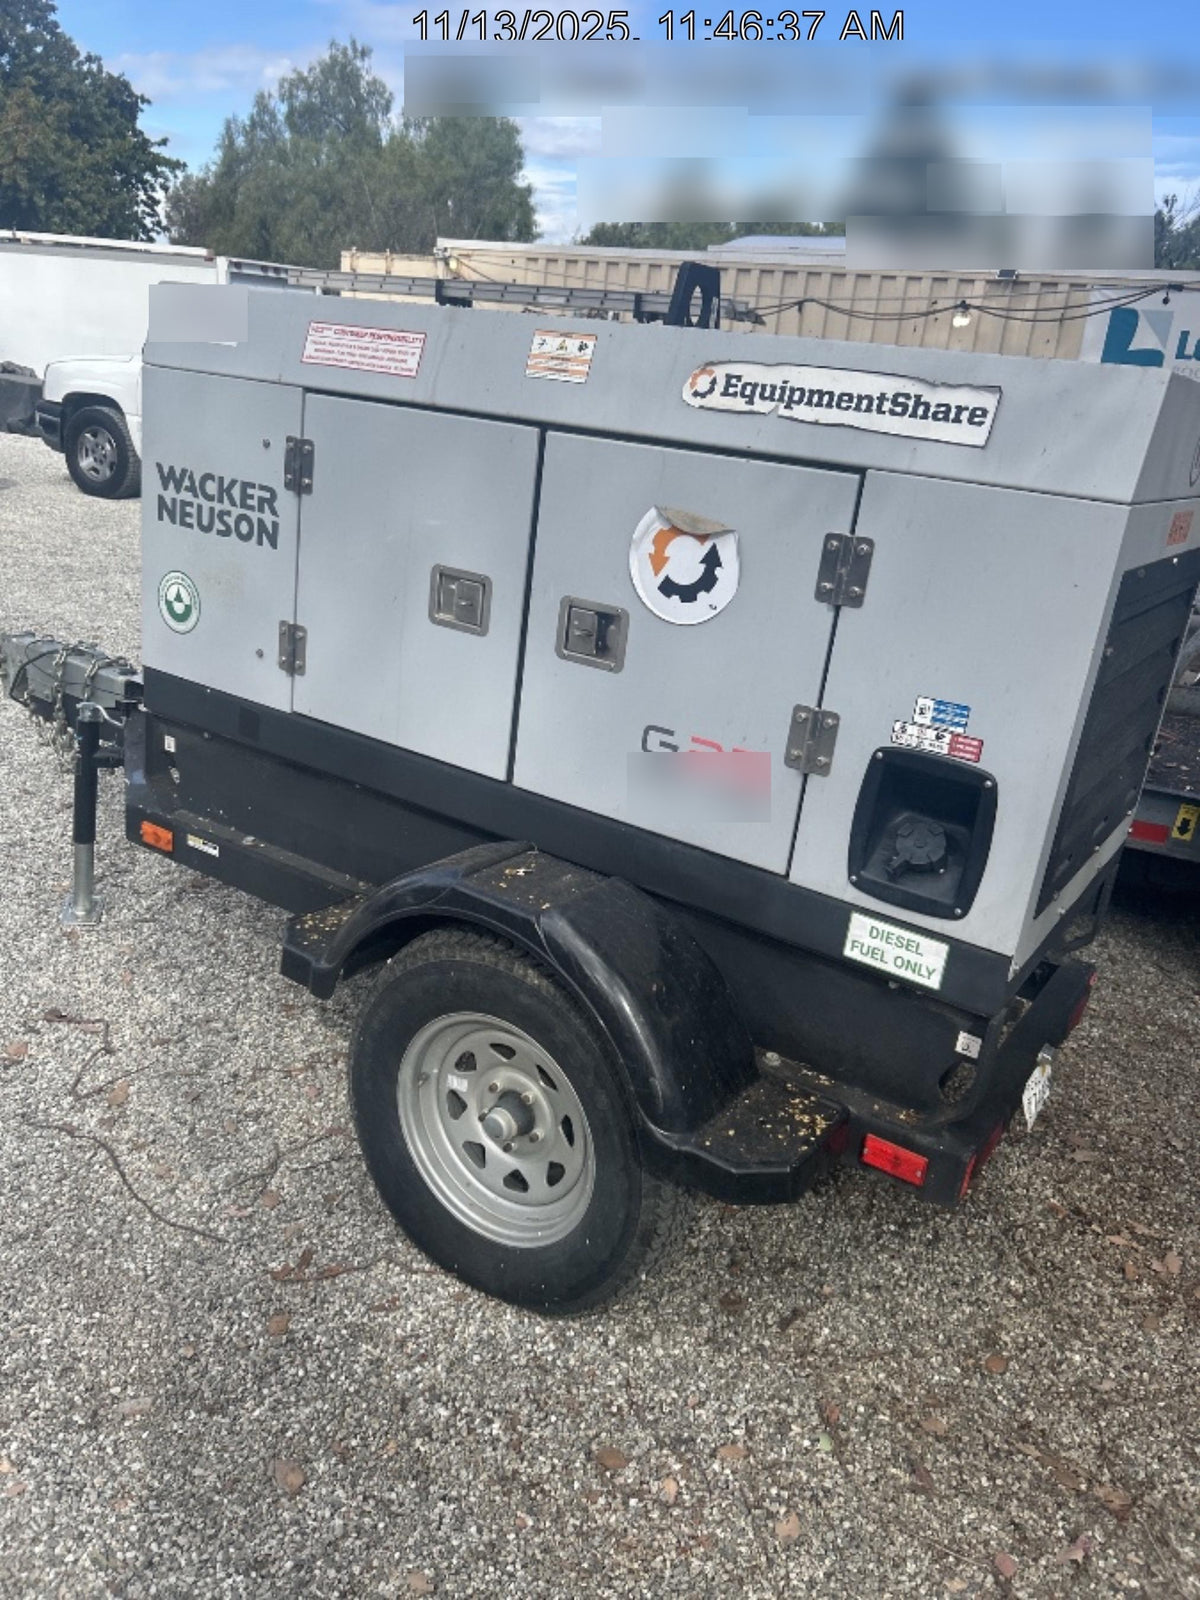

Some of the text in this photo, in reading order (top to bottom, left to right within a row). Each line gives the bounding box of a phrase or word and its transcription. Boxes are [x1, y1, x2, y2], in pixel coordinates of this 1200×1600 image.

[719, 373, 990, 428] EquipmentShare
[155, 461, 280, 518] WACKER
[157, 493, 280, 550] NEUSON
[850, 939, 936, 980] FUEL ONLY
[868, 925, 924, 958] DIESEL
